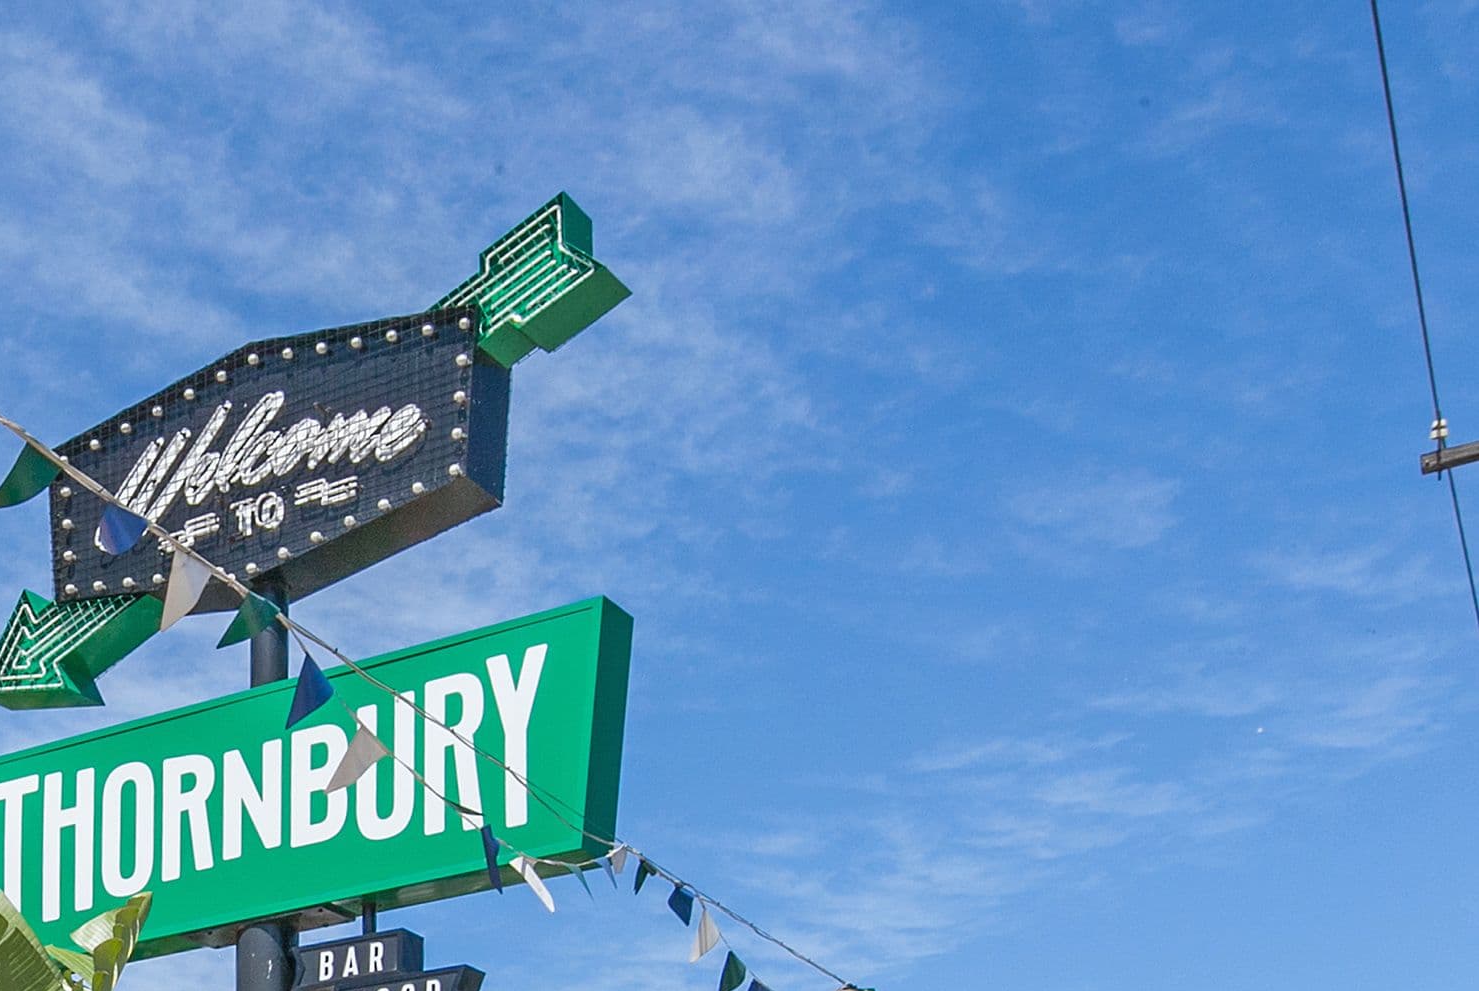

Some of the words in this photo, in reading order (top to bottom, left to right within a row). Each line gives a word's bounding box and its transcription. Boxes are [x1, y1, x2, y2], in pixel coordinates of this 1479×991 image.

[94, 390, 426, 555] Welcome
[229, 491, 285, 536] TO
[319, 941, 384, 981] BAR
